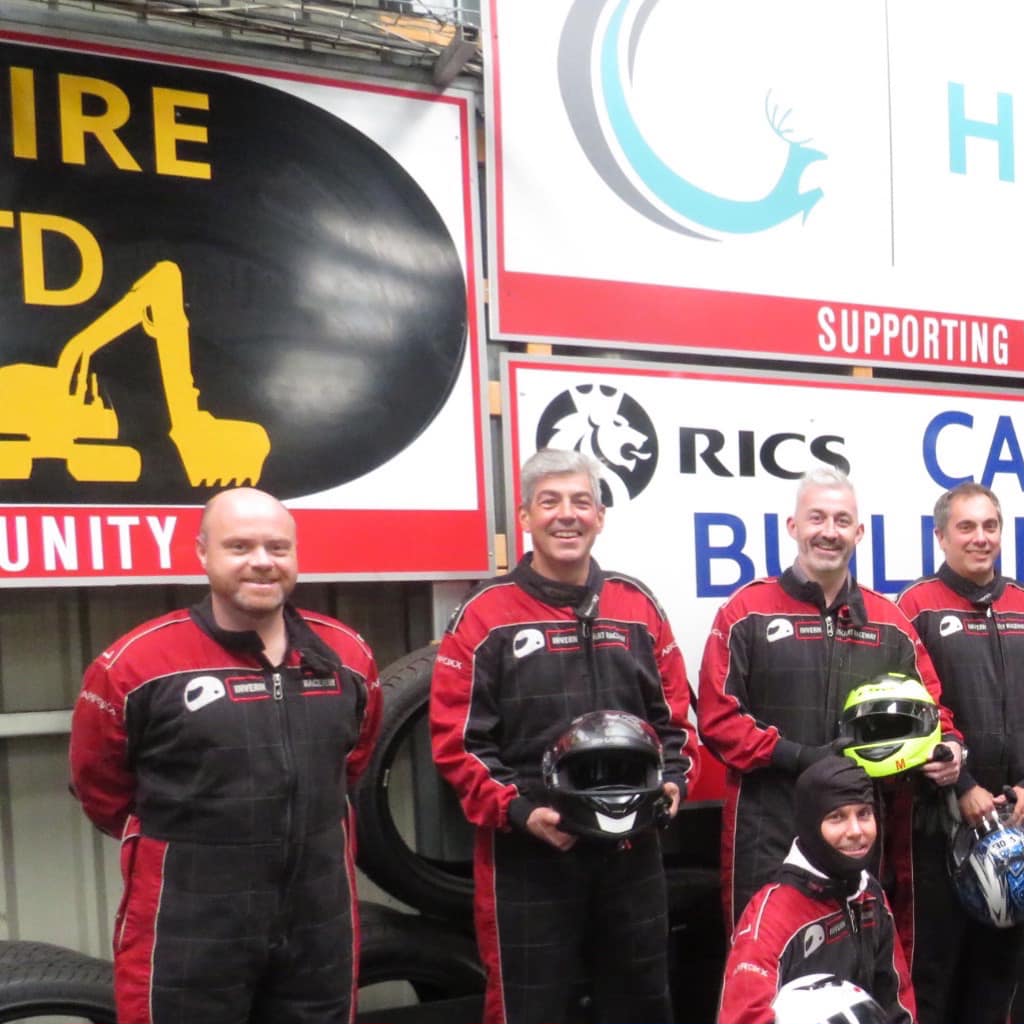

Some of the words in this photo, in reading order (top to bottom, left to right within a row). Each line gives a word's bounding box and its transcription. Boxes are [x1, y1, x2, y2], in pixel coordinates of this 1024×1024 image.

[817, 305, 1010, 367] SUPPORTING
[679, 427, 851, 481] RICS
[0, 515, 177, 572] UNITY
